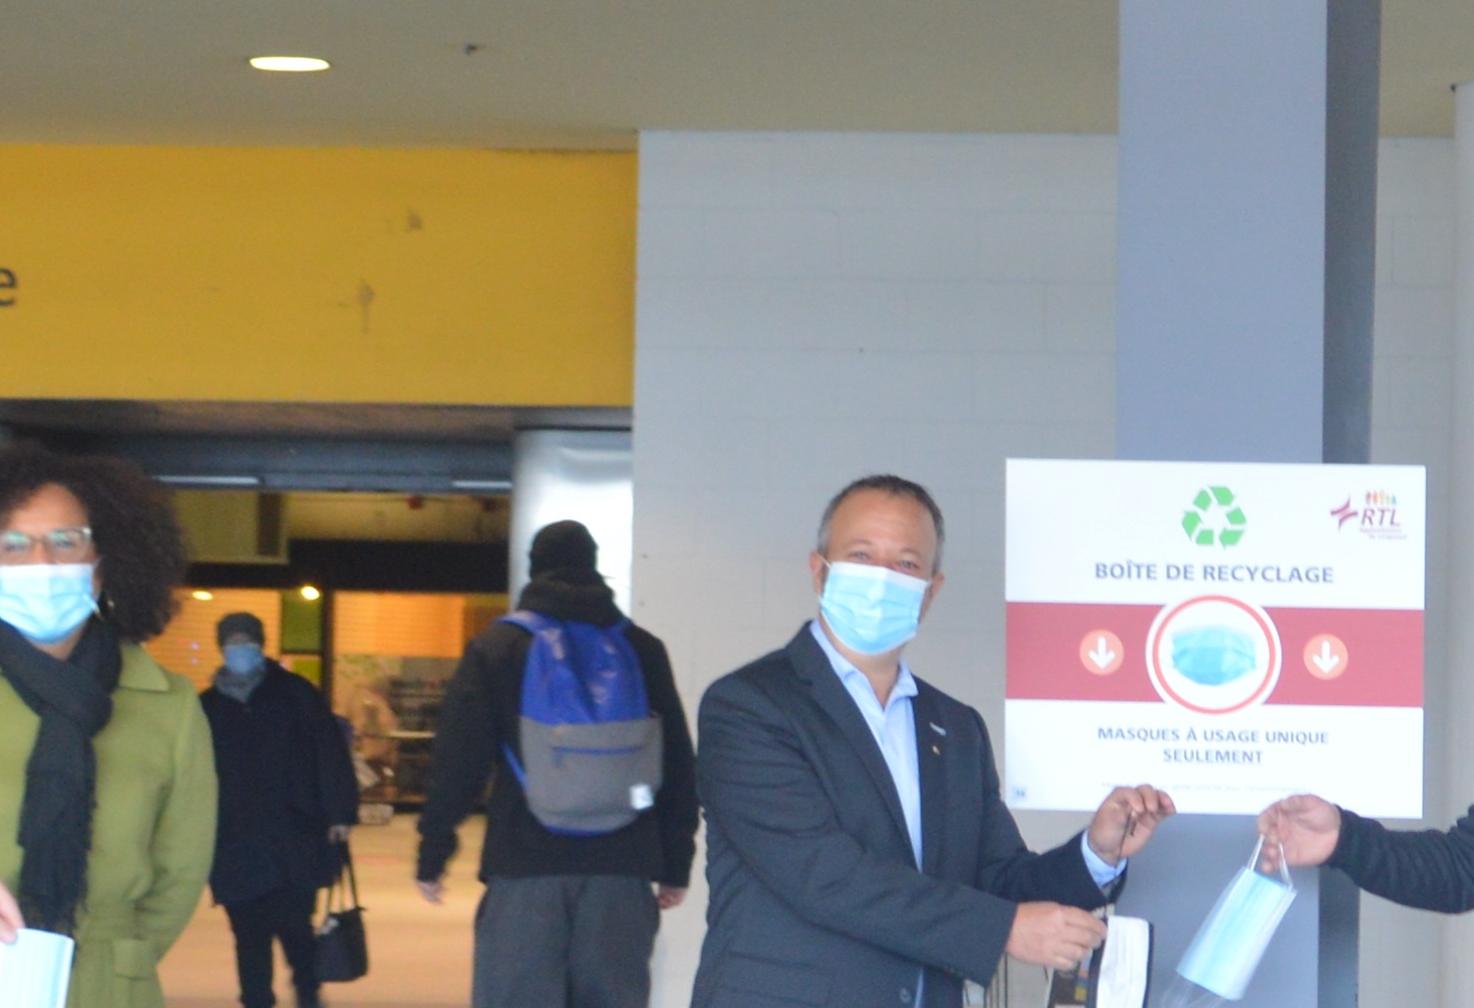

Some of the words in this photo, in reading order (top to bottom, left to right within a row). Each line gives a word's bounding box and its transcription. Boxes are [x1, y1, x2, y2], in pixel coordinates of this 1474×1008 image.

[1360, 507, 1400, 527] RTL
[1094, 559, 1158, 580] BOÎTE
[1165, 563, 1194, 581] DE
[1202, 564, 1334, 584] RECYCLAGE
[1097, 726, 1181, 743] MASQUES
[1185, 726, 1198, 742] À
[1202, 729, 1260, 744] USAGE
[1265, 730, 1329, 746] UNIQUE
[1162, 748, 1263, 765] SEULEMENT
